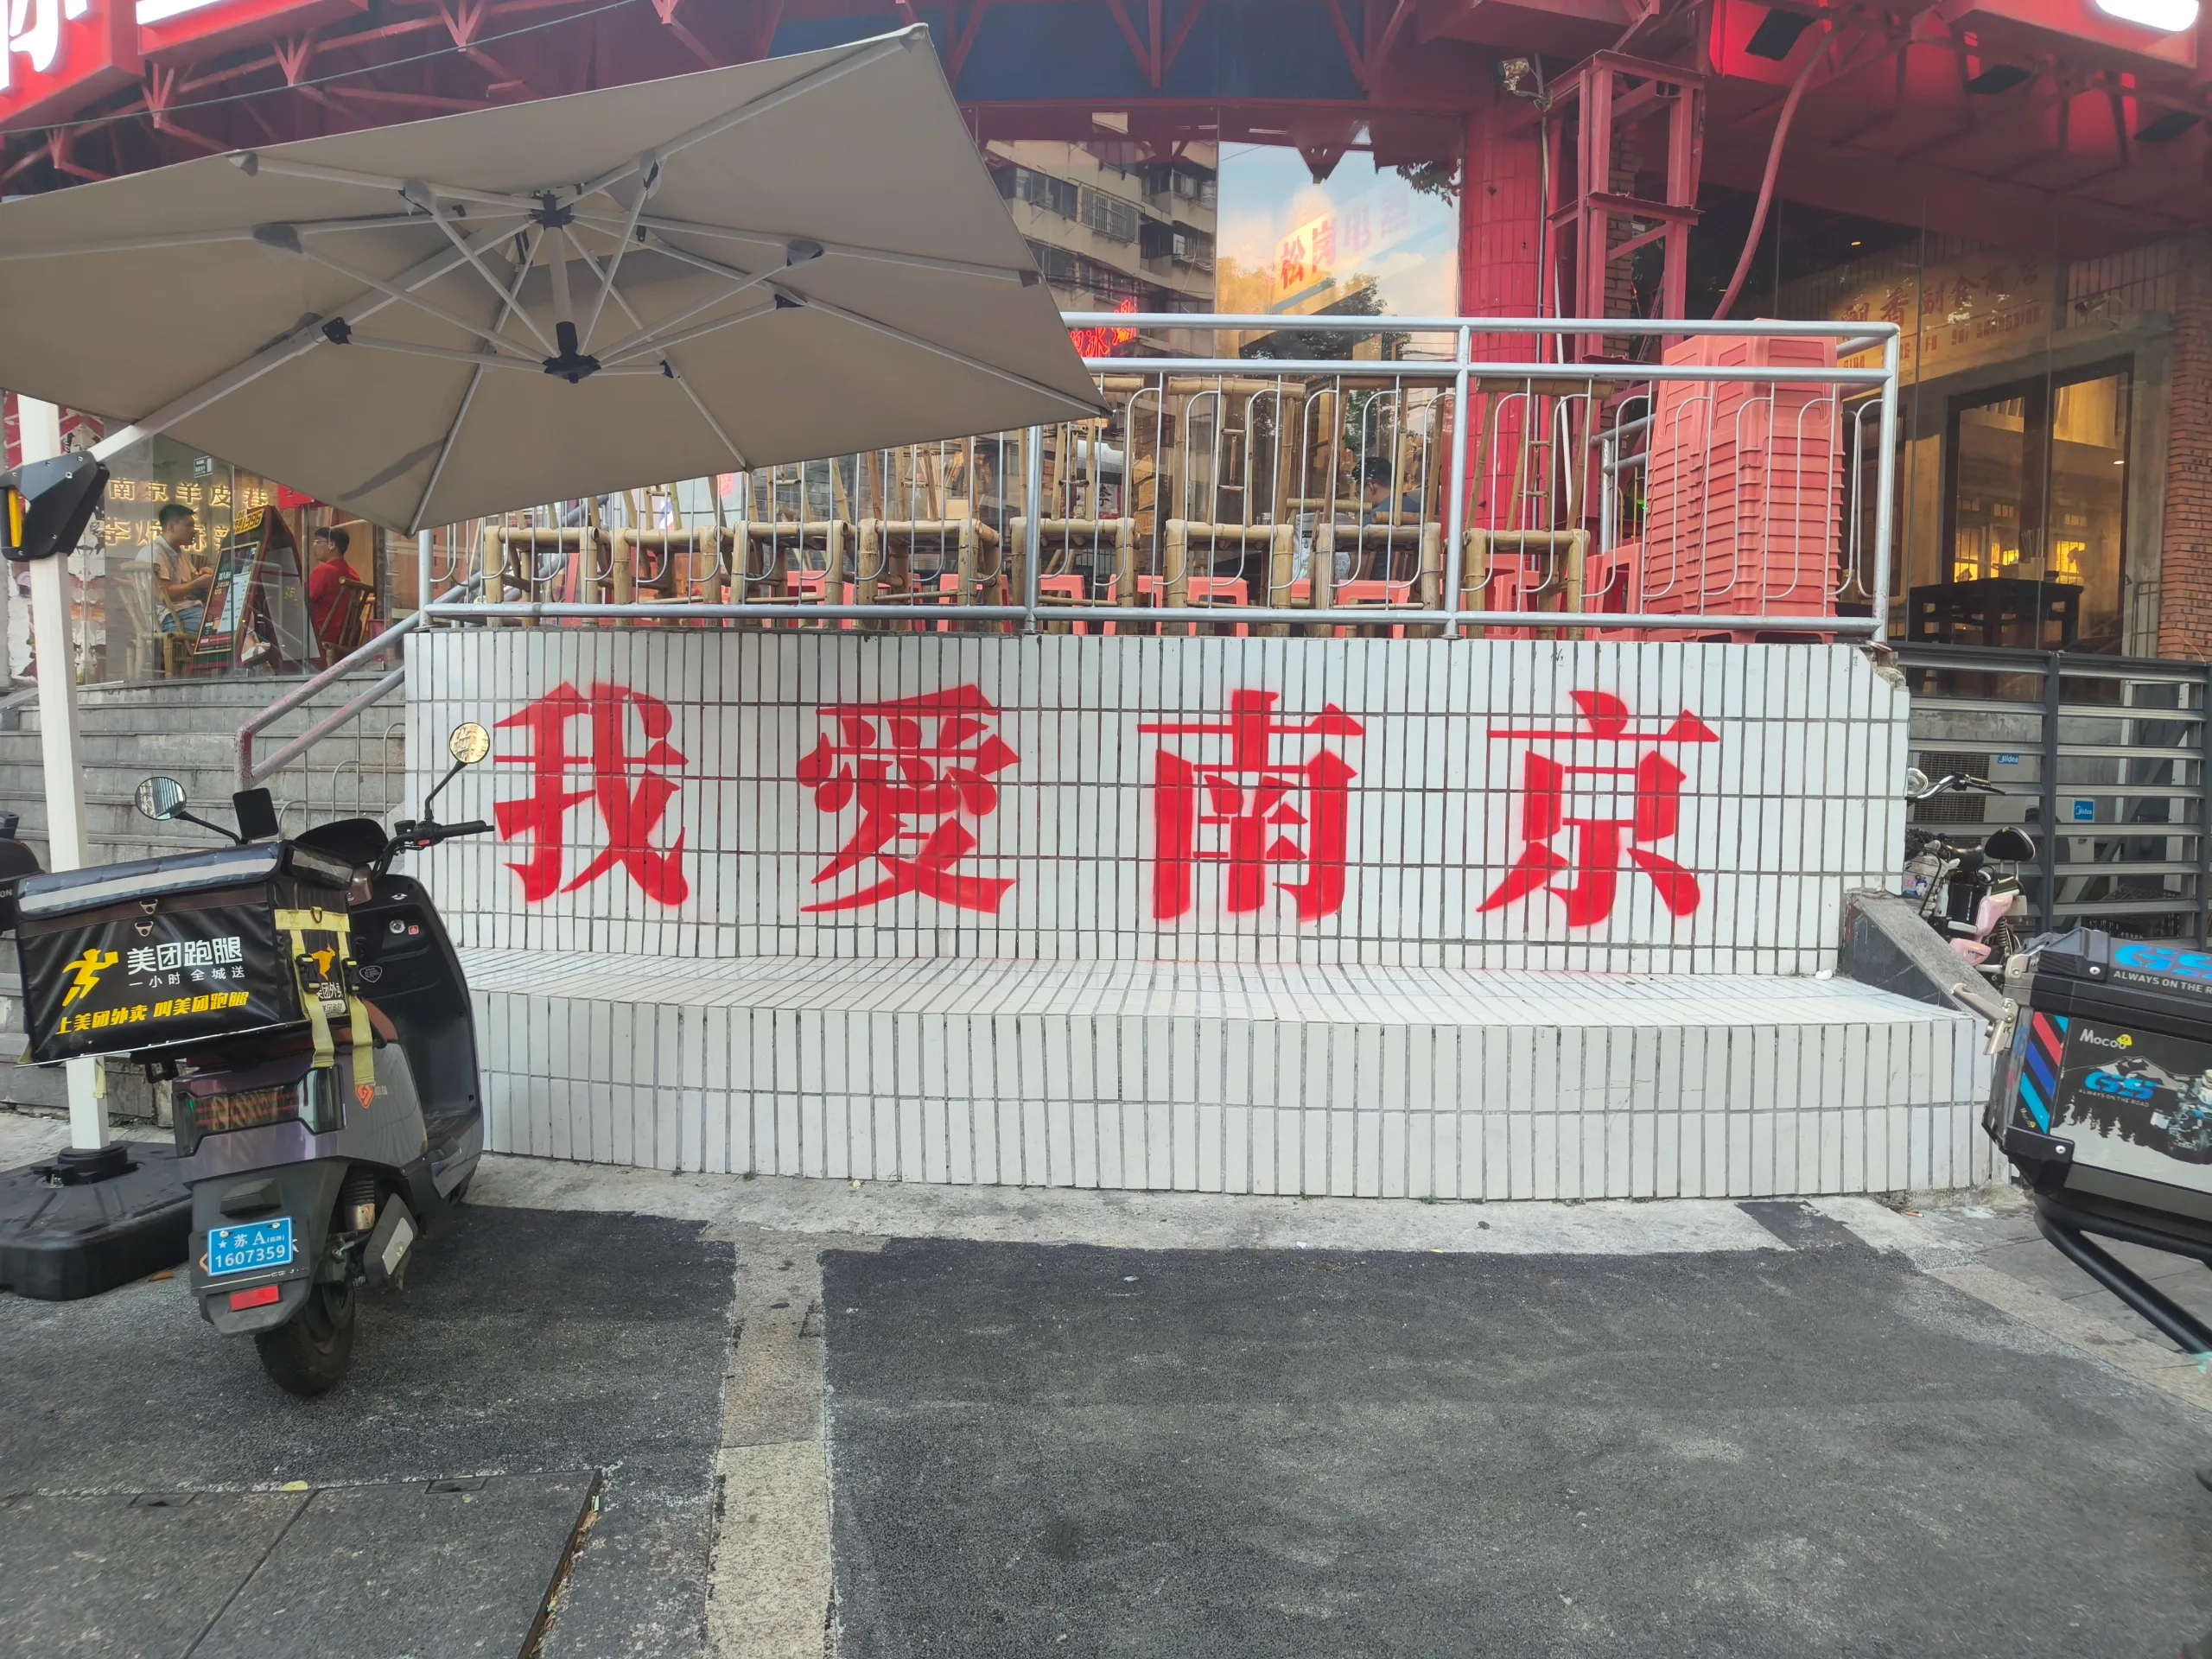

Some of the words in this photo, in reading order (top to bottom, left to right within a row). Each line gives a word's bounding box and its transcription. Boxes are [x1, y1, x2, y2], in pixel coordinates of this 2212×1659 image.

[109, 478, 269, 509] 南京羊皮巷
[127, 936, 243, 975] 美团跑腿
[2113, 970, 2160, 985] ALWAYS
[2162, 978, 2178, 988] ON
[2180, 982, 2203, 993] THE
[55, 1005, 149, 1035] 上美团外卖
[153, 991, 250, 1018] 叫美团跑腿
[215, 1244, 285, 1268] 1607359
